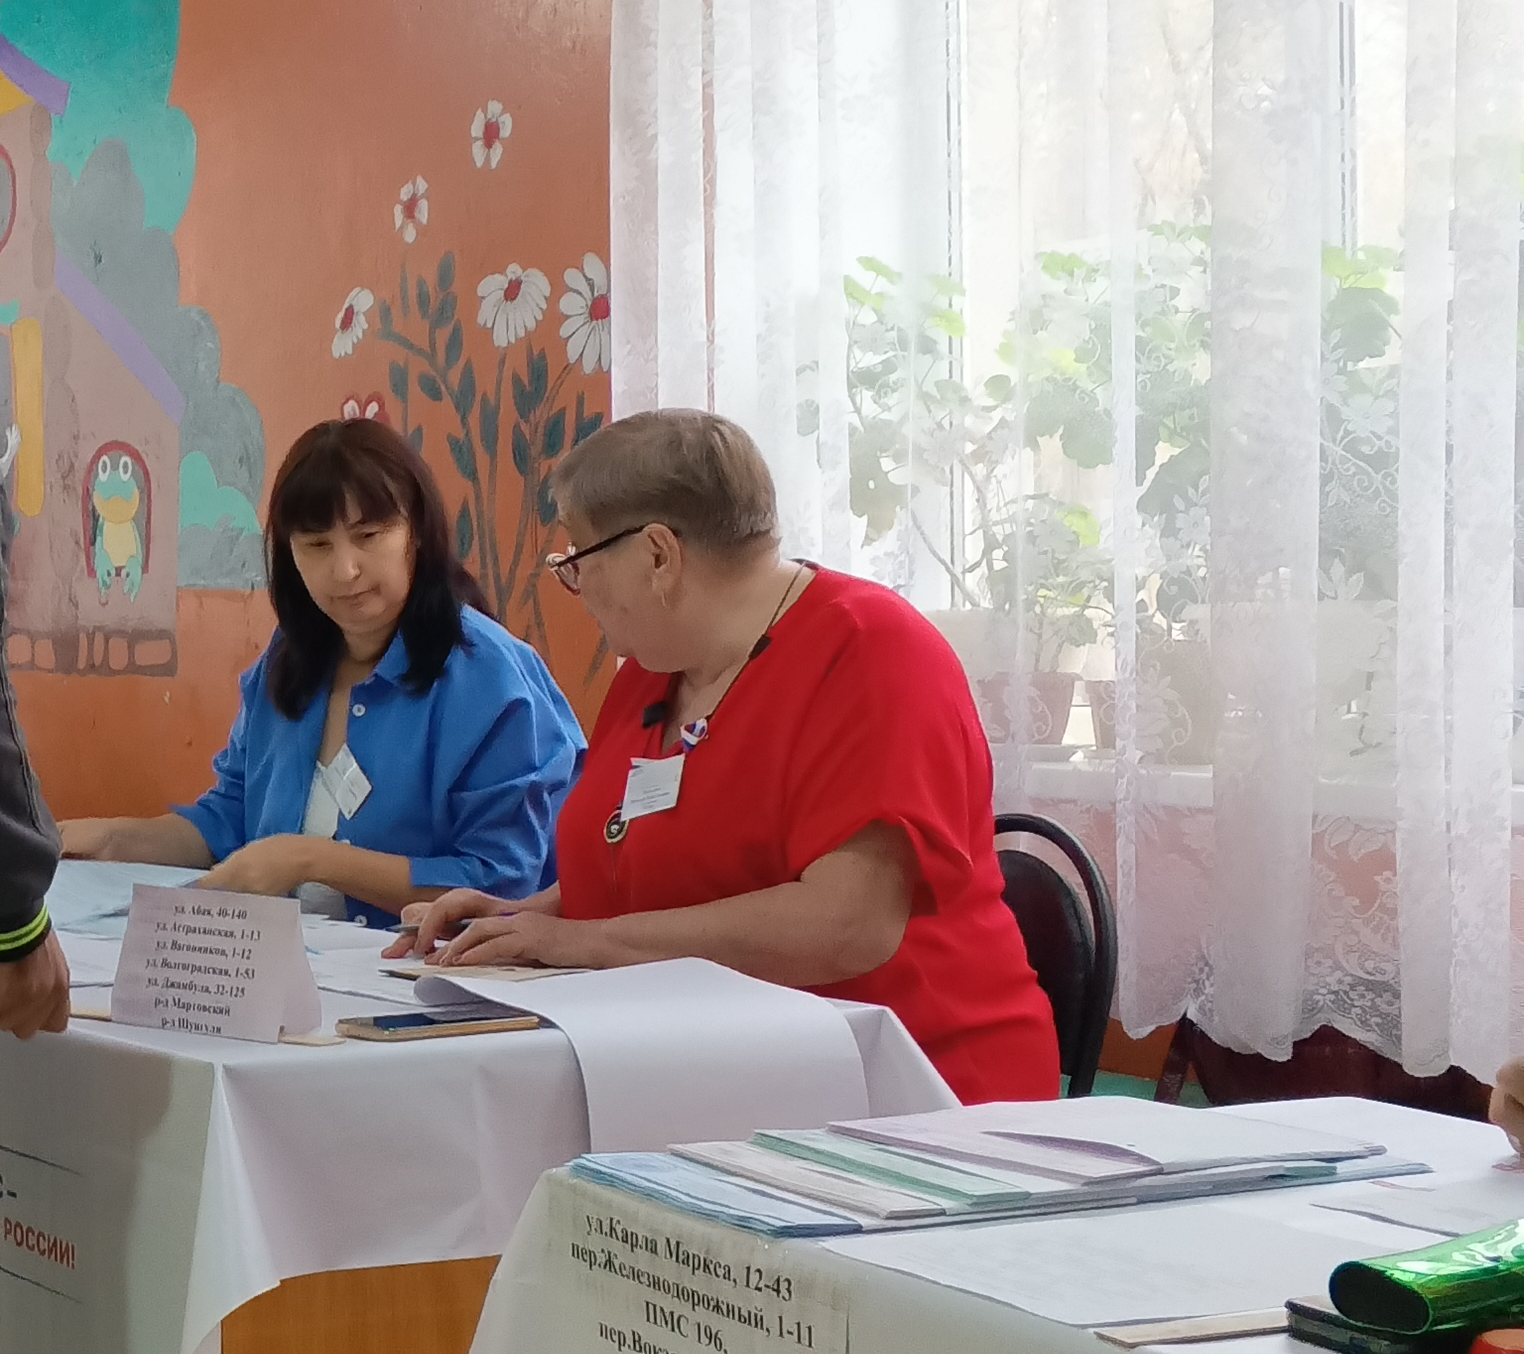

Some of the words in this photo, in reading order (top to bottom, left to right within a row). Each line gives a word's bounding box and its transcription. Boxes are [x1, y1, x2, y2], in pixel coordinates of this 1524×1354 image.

[216, 906, 247, 920] 40-140
[155, 922, 168, 933] ул.
[240, 929, 261, 941] 1-13
[155, 941, 168, 951] ул.
[232, 947, 252, 961] 1-12
[145, 958, 158, 969] ул.
[160, 957, 232, 978] Волгоградская,
[235, 967, 255, 980] 1-53
[146, 977, 160, 989] ул.
[213, 984, 246, 998] 32-125
[4, 1217, 76, 1270] РОССИИ!
[586, 1214, 659, 1255] ул.Карла
[663, 1237, 738, 1289] Маркса,
[744, 1265, 793, 1302] 12-43
[571, 1241, 771, 1338] пер.Железнодорожный,
[777, 1315, 815, 1349] 1-11
[644, 1299, 689, 1339] ПМС
